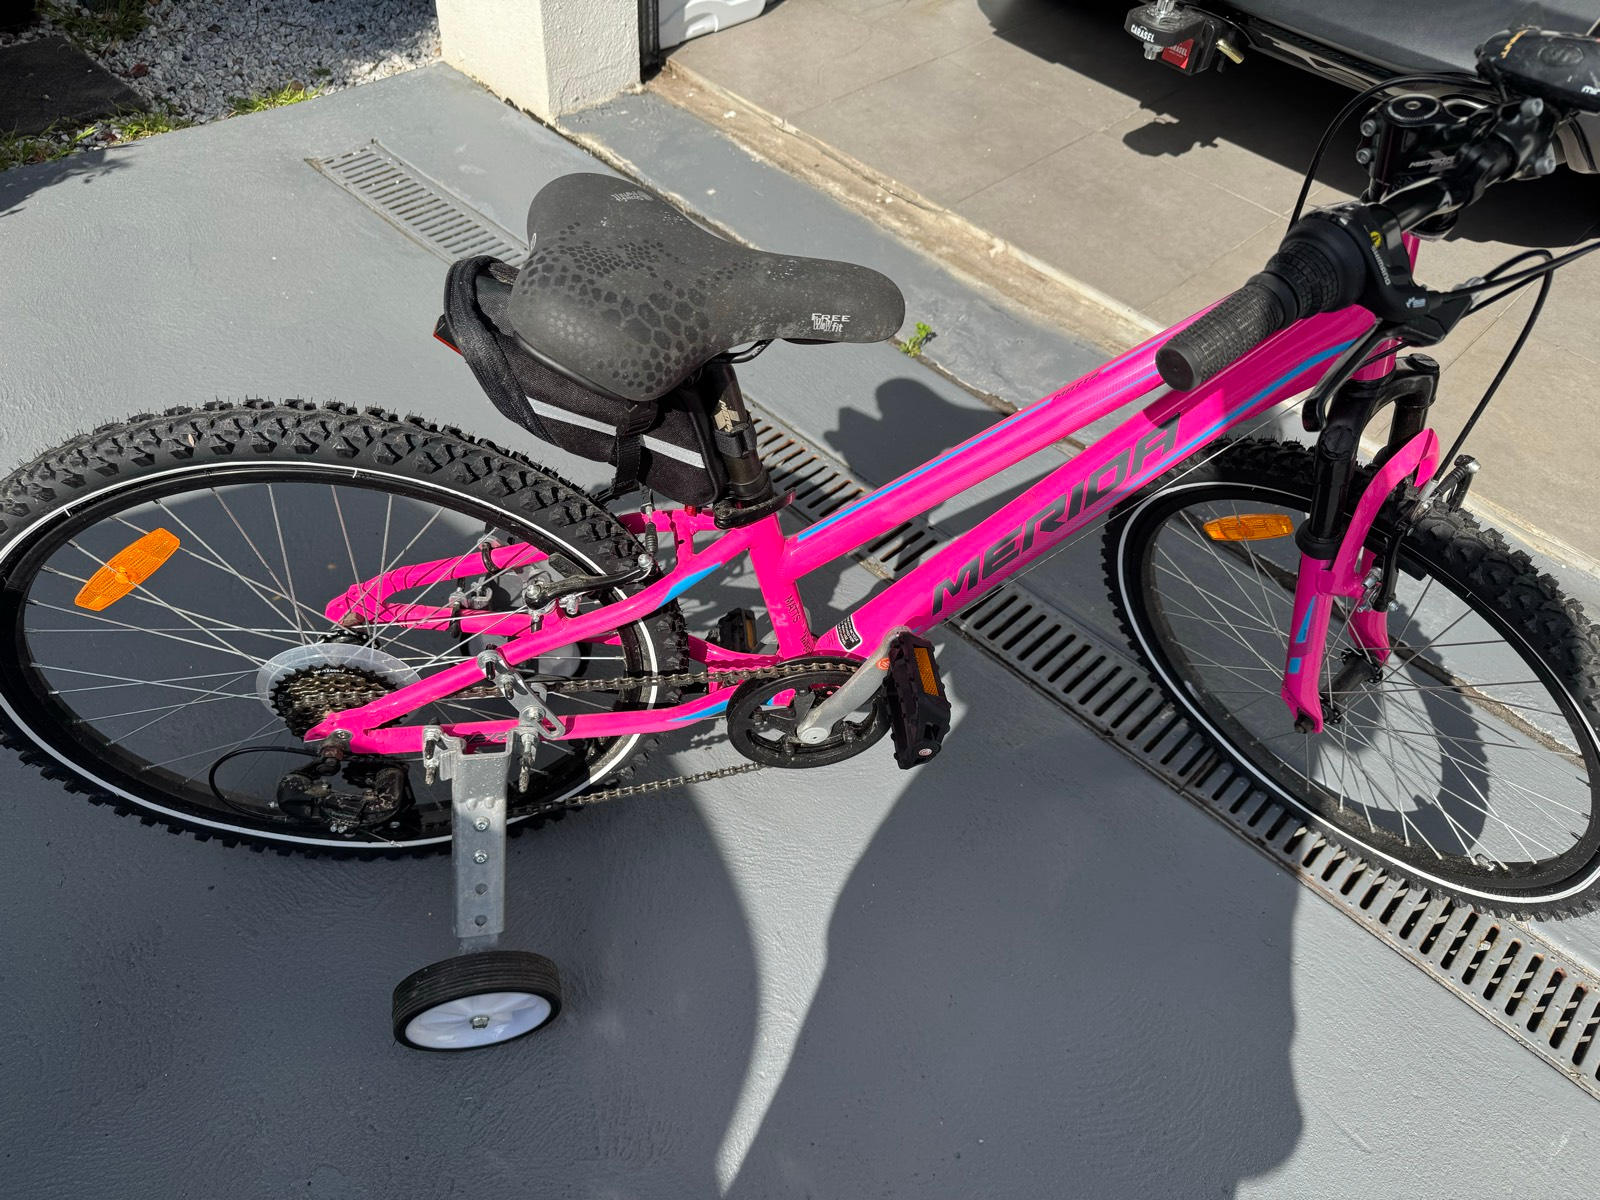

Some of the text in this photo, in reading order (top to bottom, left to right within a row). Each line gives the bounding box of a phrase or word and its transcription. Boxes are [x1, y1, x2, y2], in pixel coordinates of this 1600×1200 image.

[1130, 24, 1155, 43] CARASEL
[1371, 244, 1391, 286] SHIMANO
[811, 312, 851, 322] FREE
[932, 412, 1181, 616] MERIDA
[785, 594, 801, 624] MATTS
